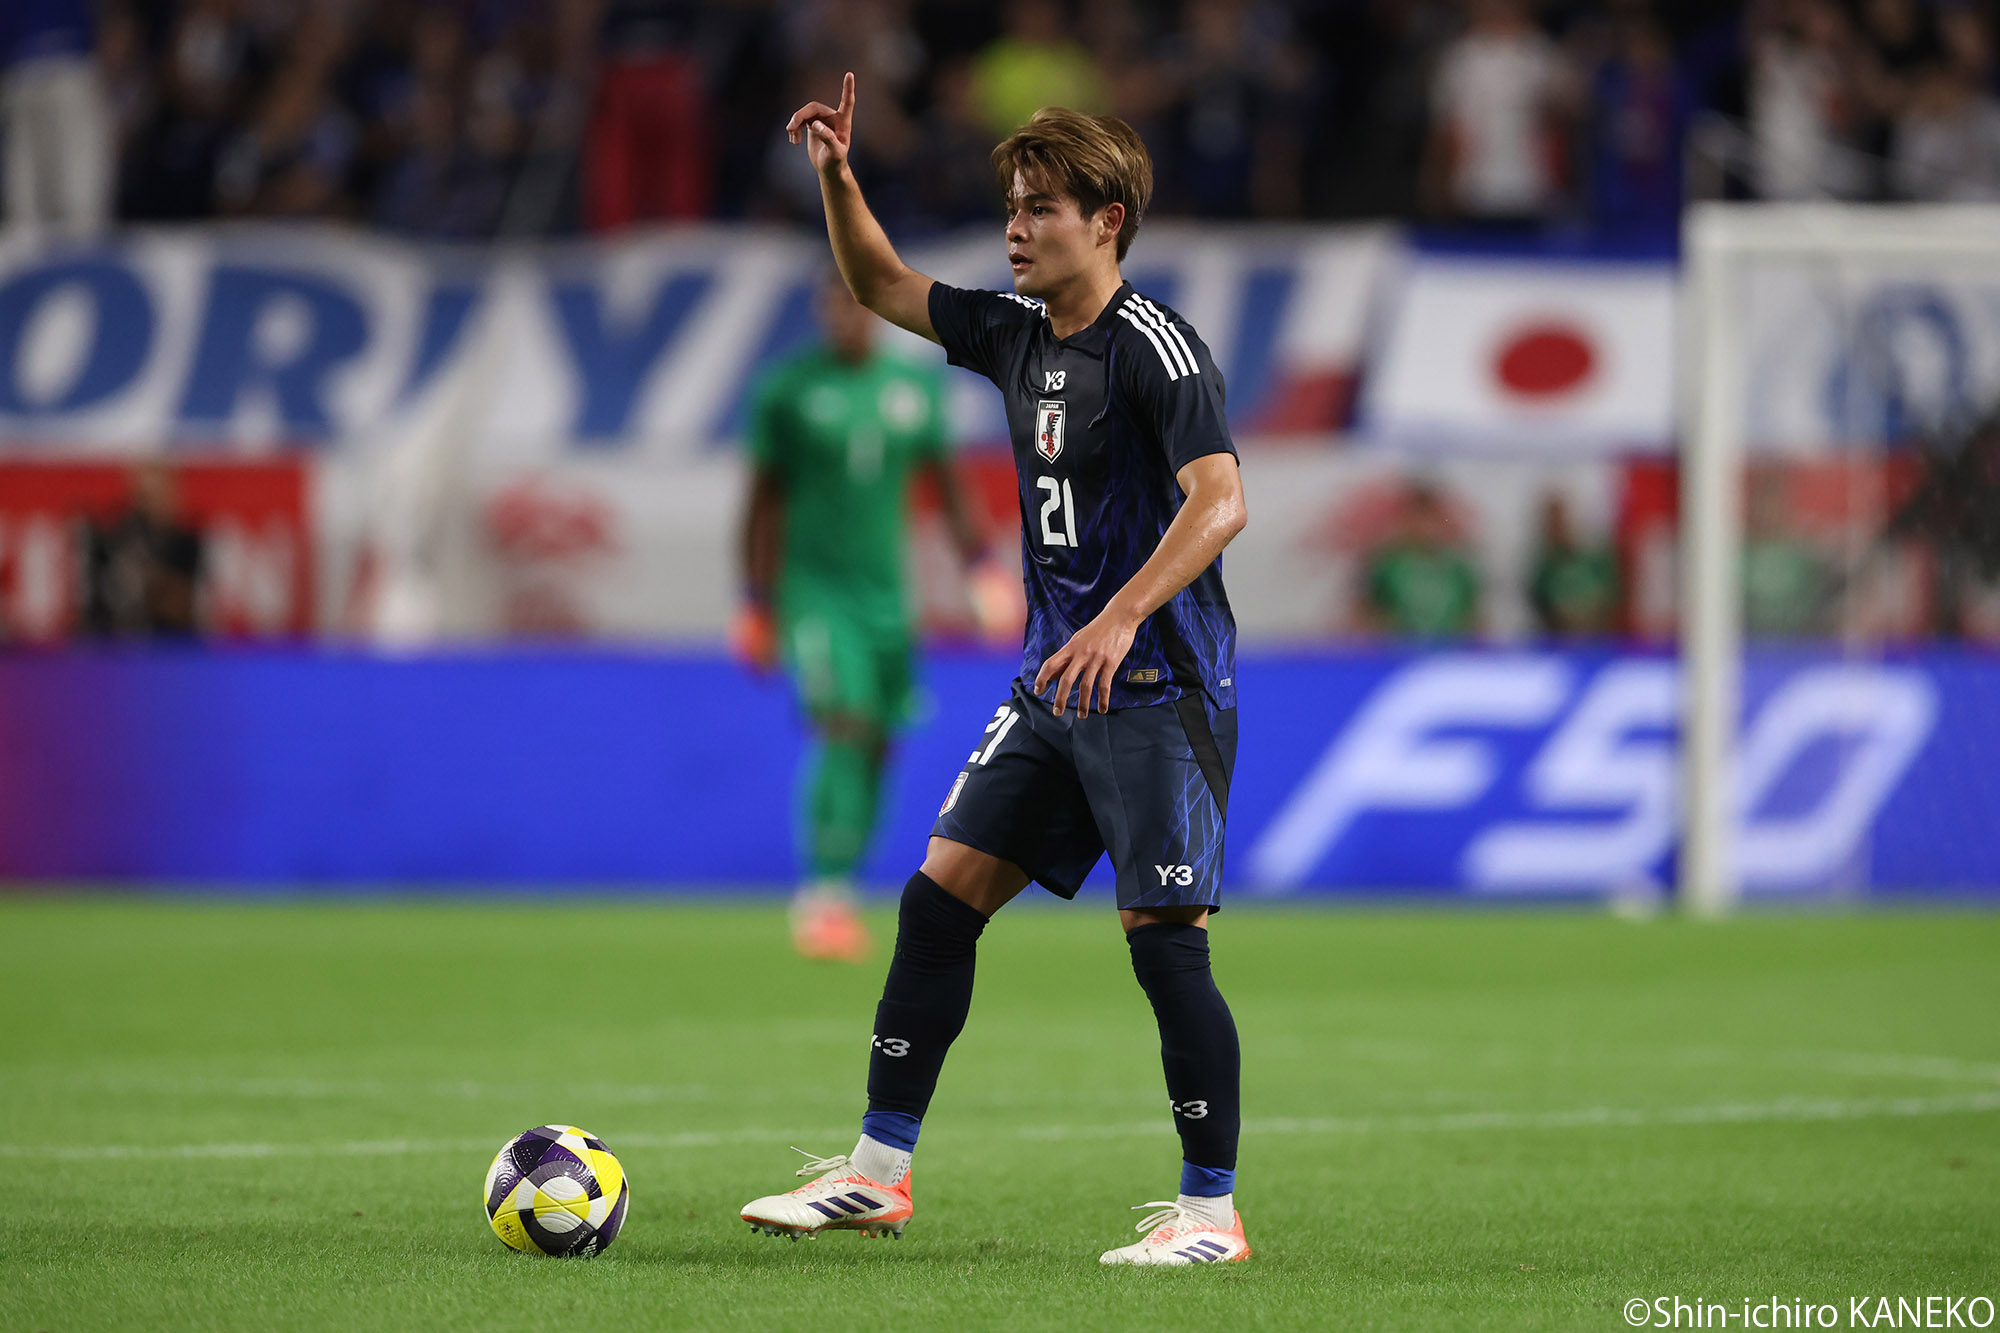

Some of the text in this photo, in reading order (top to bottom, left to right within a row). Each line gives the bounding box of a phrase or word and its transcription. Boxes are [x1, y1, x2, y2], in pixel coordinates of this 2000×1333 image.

[1044, 370, 1066, 391] Y-3
[1037, 475, 1079, 548] 21
[967, 705, 1020, 766] 21
[1248, 658, 1938, 892] F50
[1154, 864, 1194, 886] Y-3
